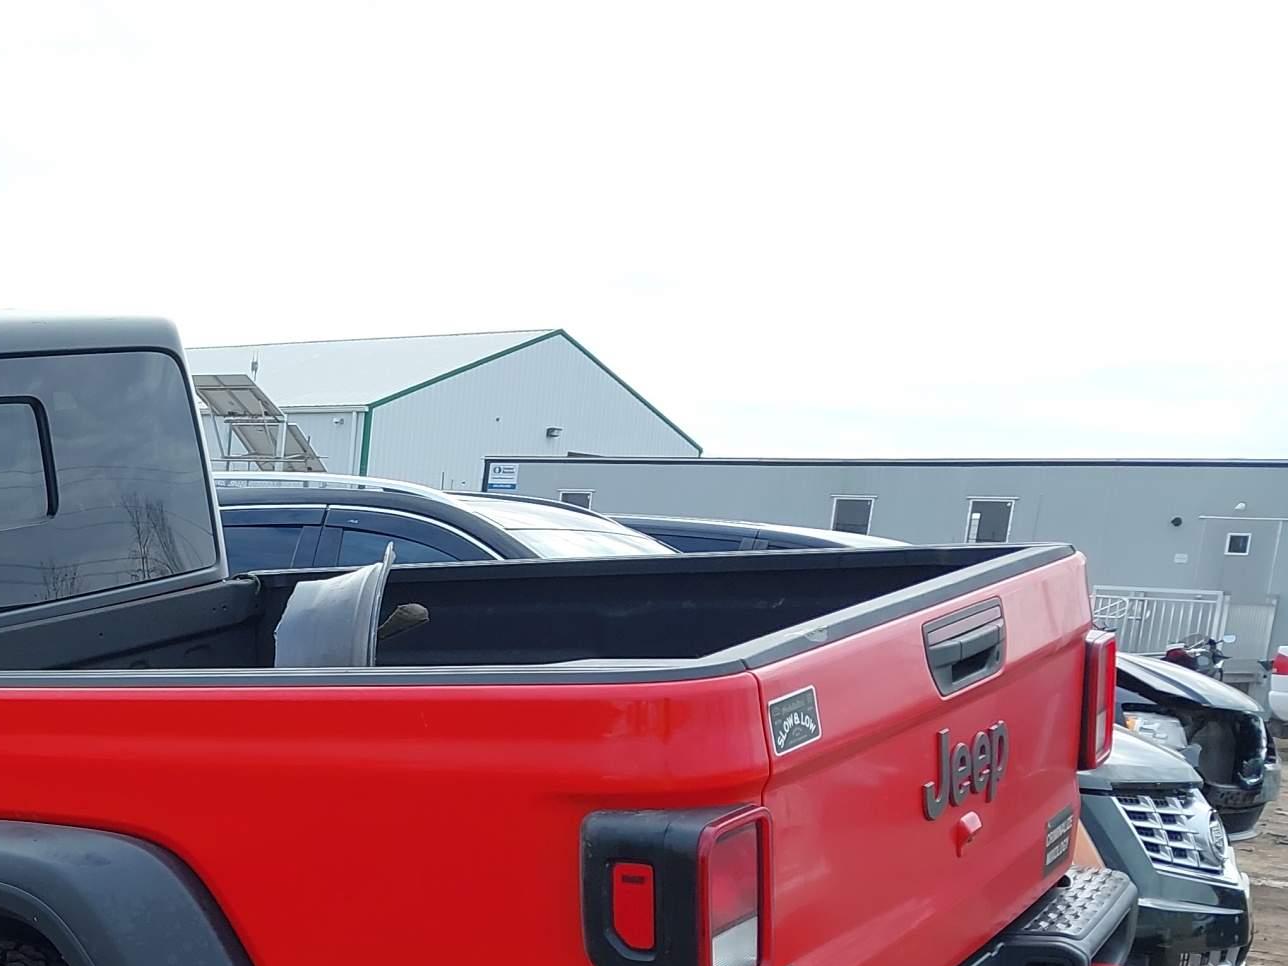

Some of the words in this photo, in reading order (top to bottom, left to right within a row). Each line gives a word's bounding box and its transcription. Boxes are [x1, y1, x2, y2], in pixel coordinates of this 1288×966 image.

[777, 712, 794, 749] SLOW
[800, 711, 817, 734] LOW
[922, 720, 1009, 821] Jeep
